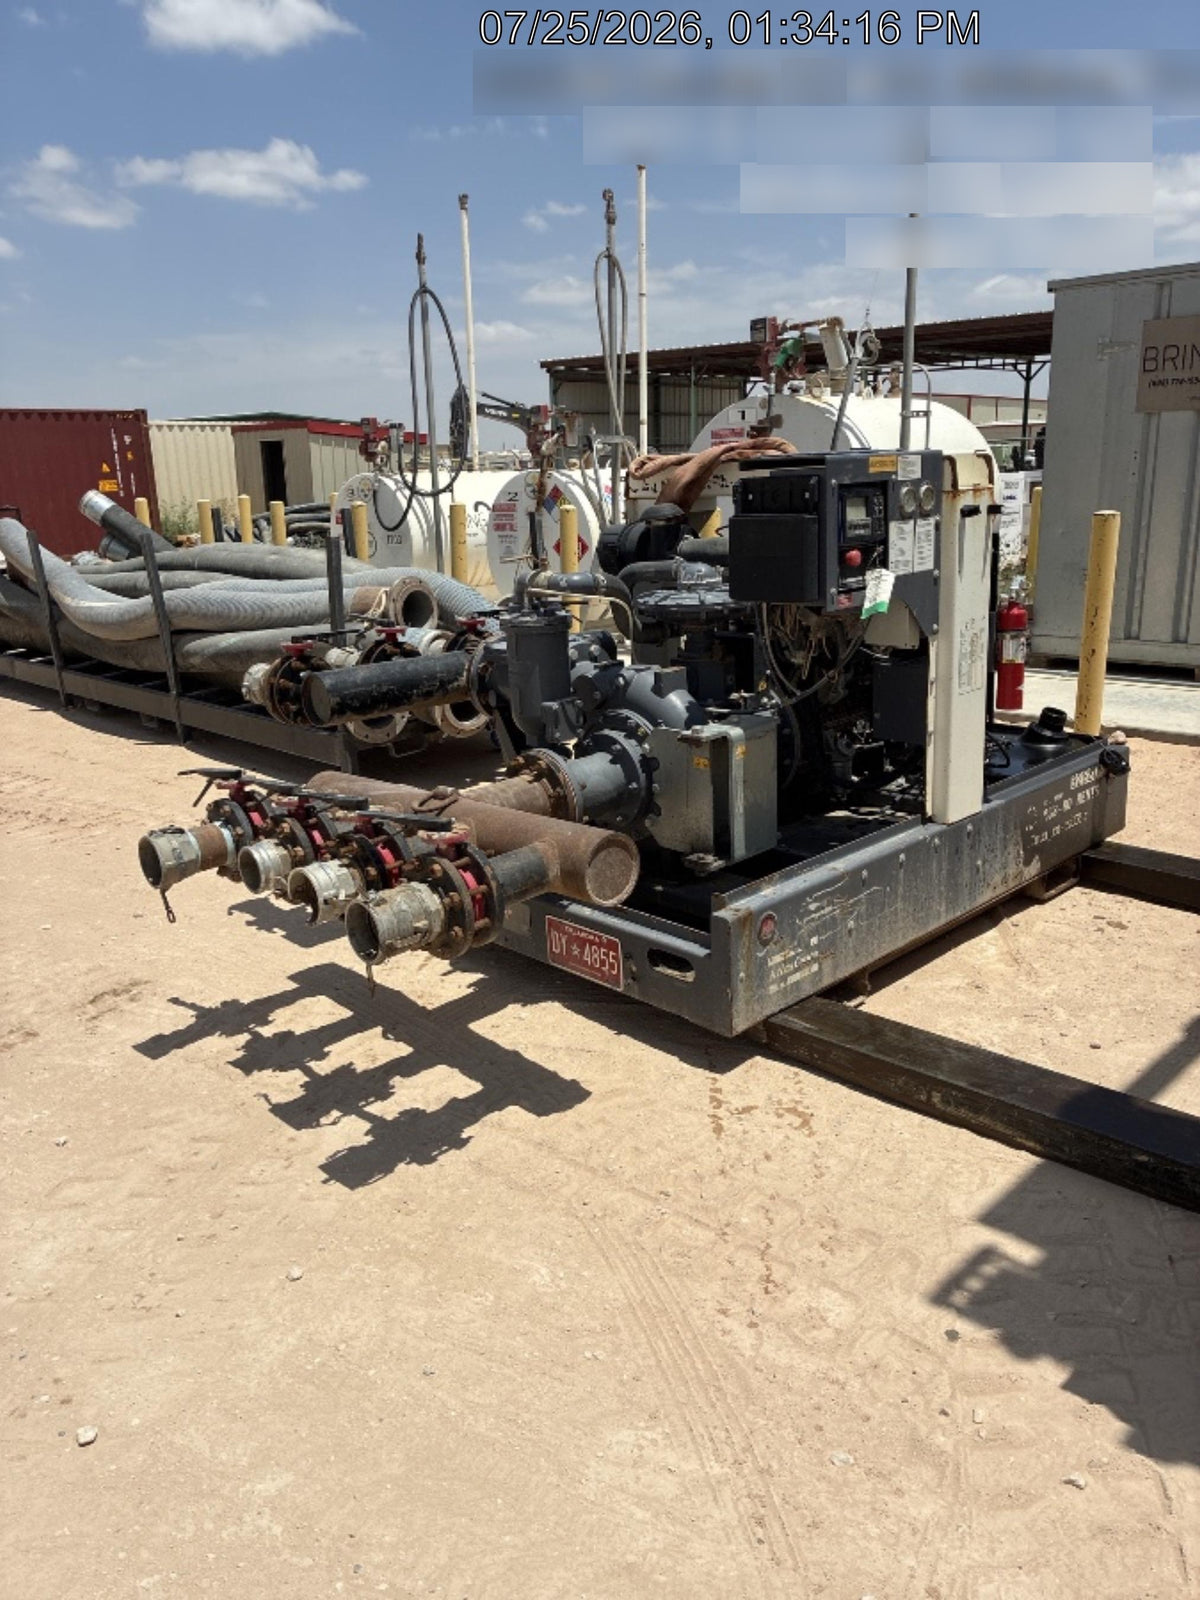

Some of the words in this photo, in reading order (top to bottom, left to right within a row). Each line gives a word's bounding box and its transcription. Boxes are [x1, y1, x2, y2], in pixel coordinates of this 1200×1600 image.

[737, 410, 746, 421] 1
[507, 491, 519, 502] 2
[583, 942, 618, 976] 4855
